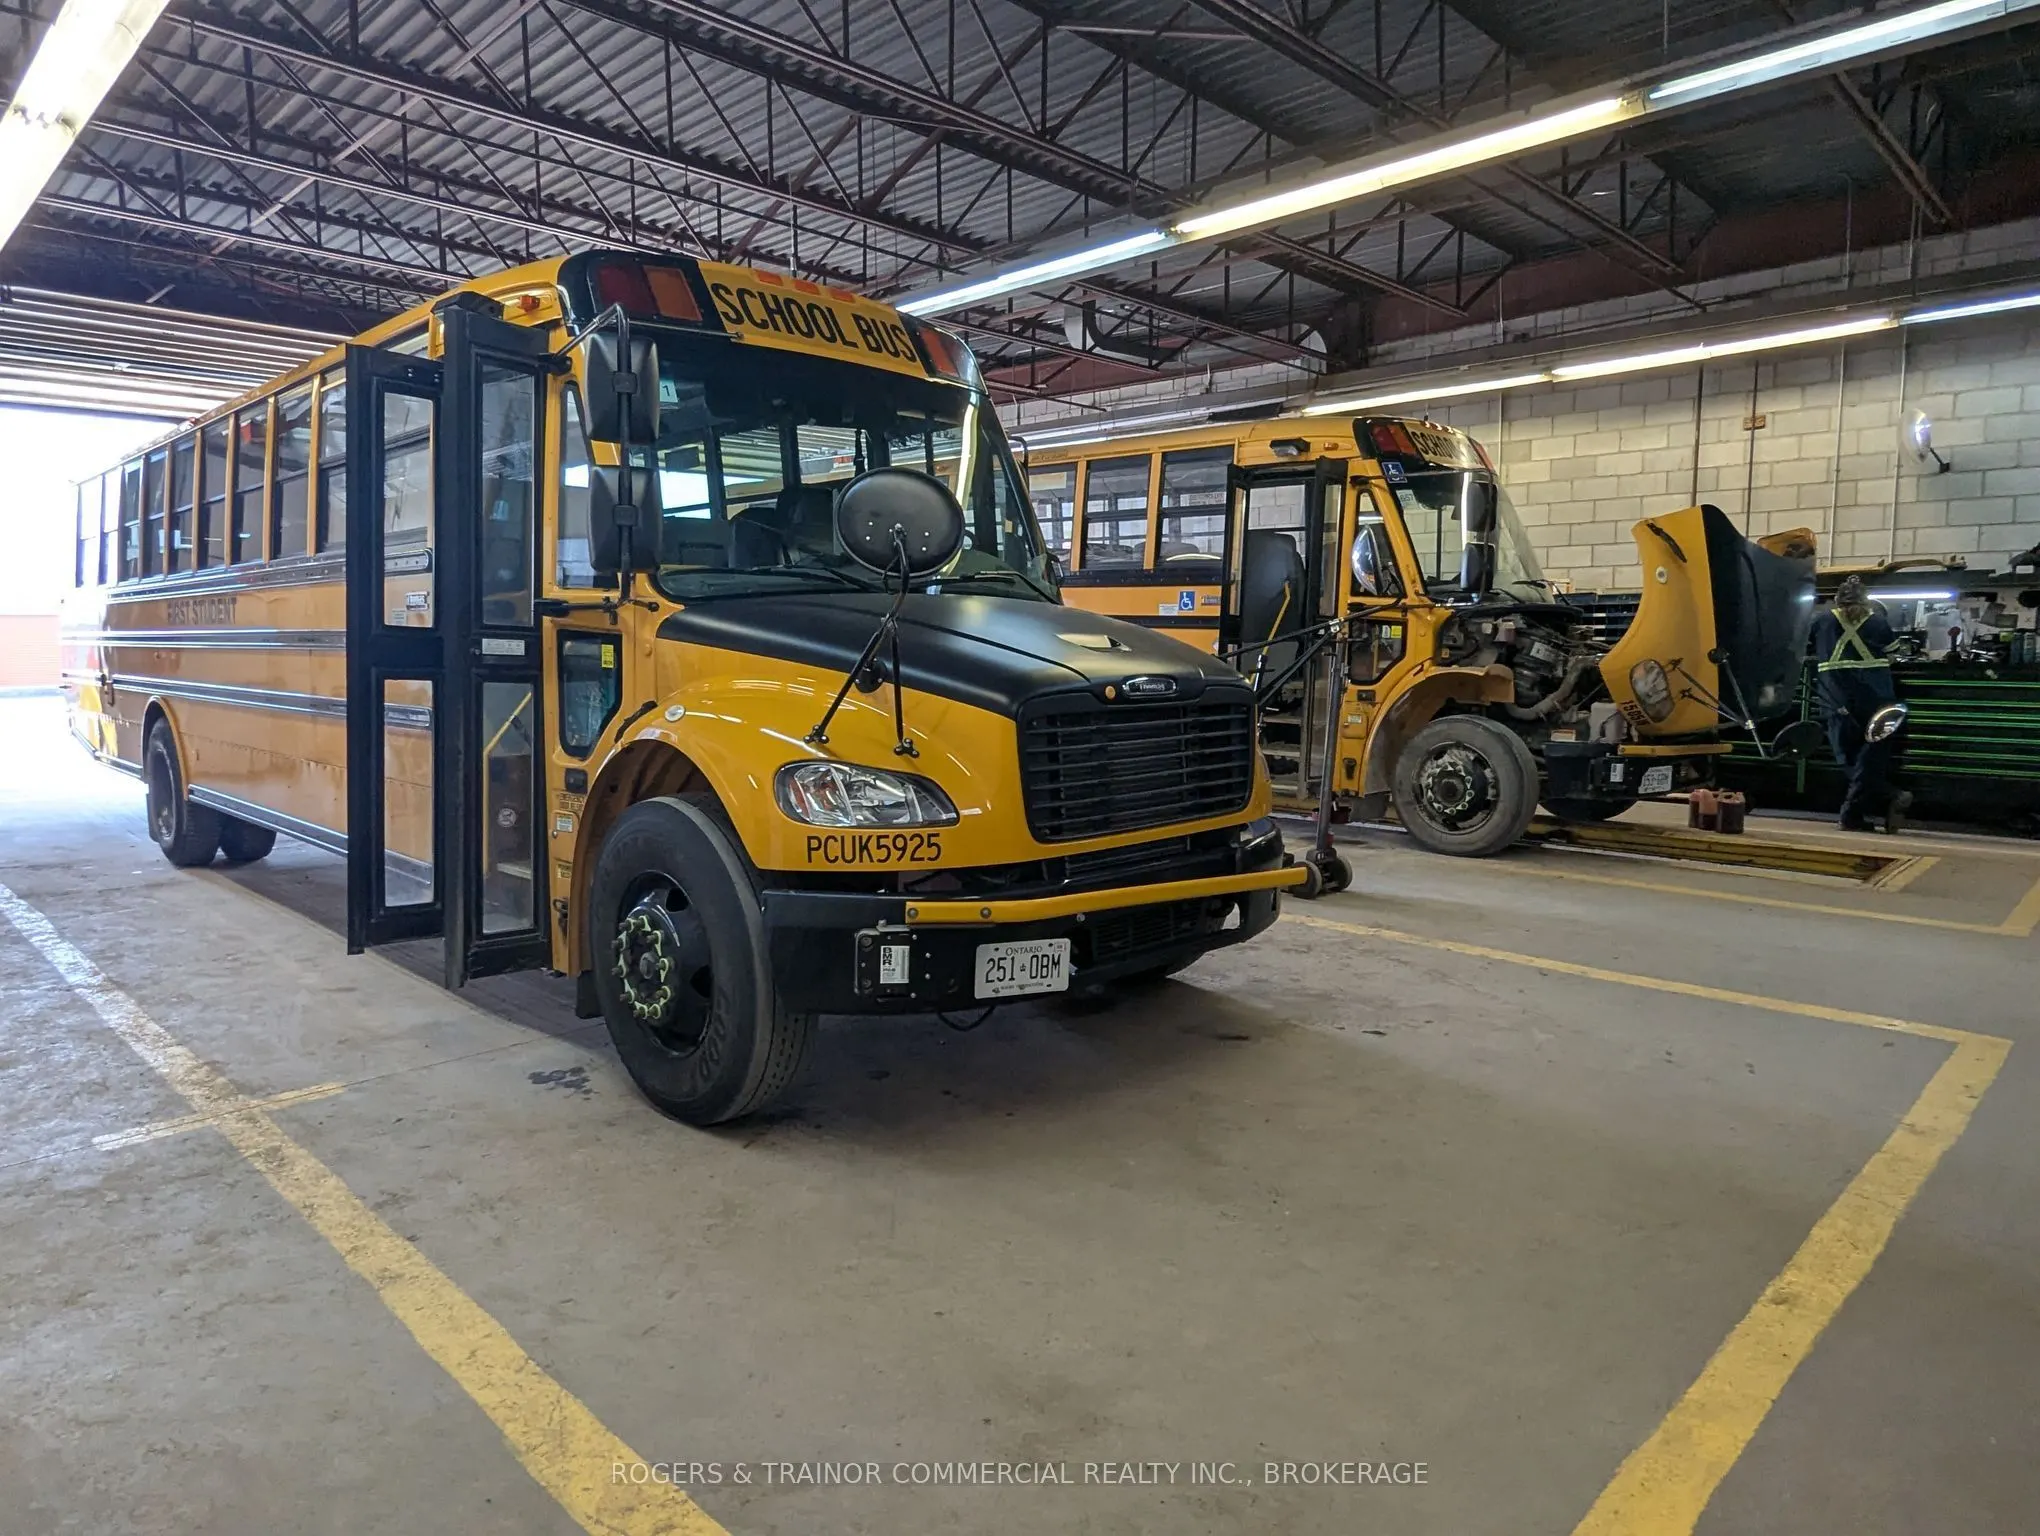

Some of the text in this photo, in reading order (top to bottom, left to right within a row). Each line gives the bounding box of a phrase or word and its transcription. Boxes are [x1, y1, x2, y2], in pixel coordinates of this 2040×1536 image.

[710, 283, 917, 363] SCHOOL BUS
[192, 597, 237, 625] STUDENT
[806, 833, 942, 864] PCUK5925
[985, 956, 1016, 984] 251
